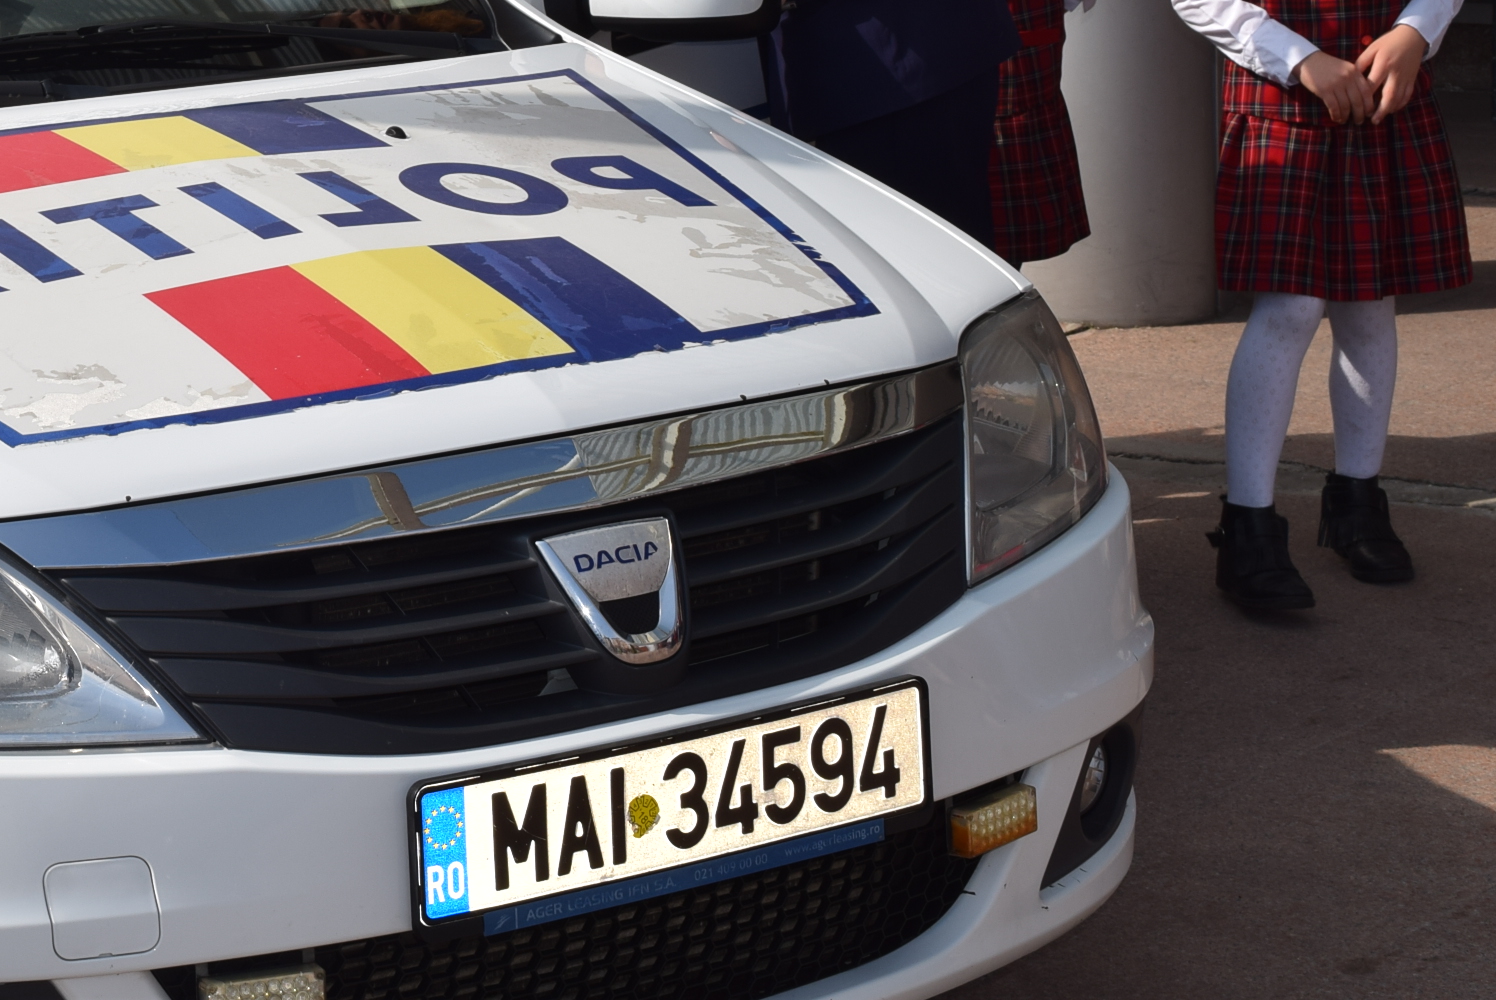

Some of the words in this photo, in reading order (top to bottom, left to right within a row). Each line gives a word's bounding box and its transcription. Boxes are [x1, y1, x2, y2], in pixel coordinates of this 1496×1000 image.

[573, 540, 659, 574] DACIA
[491, 766, 627, 892] MAI
[662, 704, 901, 851] 34594
[427, 861, 466, 906] RO
[526, 902, 564, 922] AGER
[567, 887, 624, 912] LEASING
[628, 882, 651, 898] IFN
[693, 866, 715, 882] 021
[717, 861, 737, 877] 409
[738, 857, 754, 872] 00
[754, 853, 769, 867] 00
